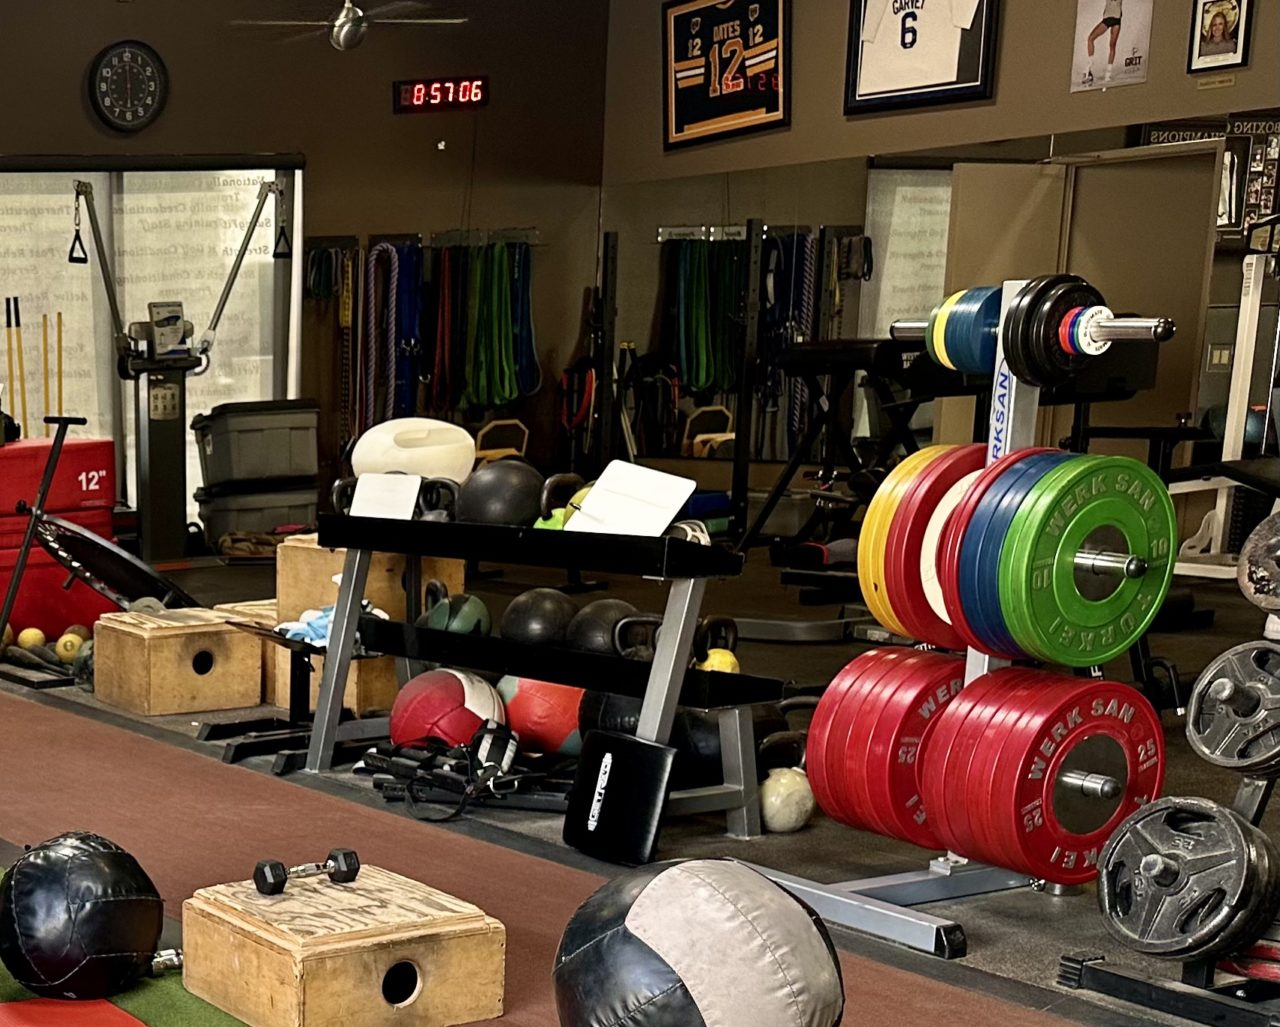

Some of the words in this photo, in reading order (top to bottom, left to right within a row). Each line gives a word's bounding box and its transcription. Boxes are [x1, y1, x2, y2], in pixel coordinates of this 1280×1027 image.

[748, 24, 763, 46] 12
[900, 11, 918, 49] 6
[687, 38, 702, 58] 12
[145, 67, 152, 76] 2
[709, 37, 745, 98] 12
[1124, 55, 1142, 68] GRIT
[100, 82, 107, 92] 9
[148, 82, 155, 91] 3
[145, 97, 152, 105] 4
[113, 108, 119, 117] 7
[125, 111, 132, 120] 6
[137, 108, 144, 116] 5
[77, 470, 107, 491] 12"
[1045, 474, 1107, 538] WERK
[1115, 473, 1157, 511] SAN
[1150, 538, 1168, 558] 10
[918, 677, 963, 720] WER
[1028, 705, 1084, 780] WERK
[1090, 698, 1136, 724] SAN
[1137, 738, 1156, 763] 25
[1023, 807, 1043, 833] 25
